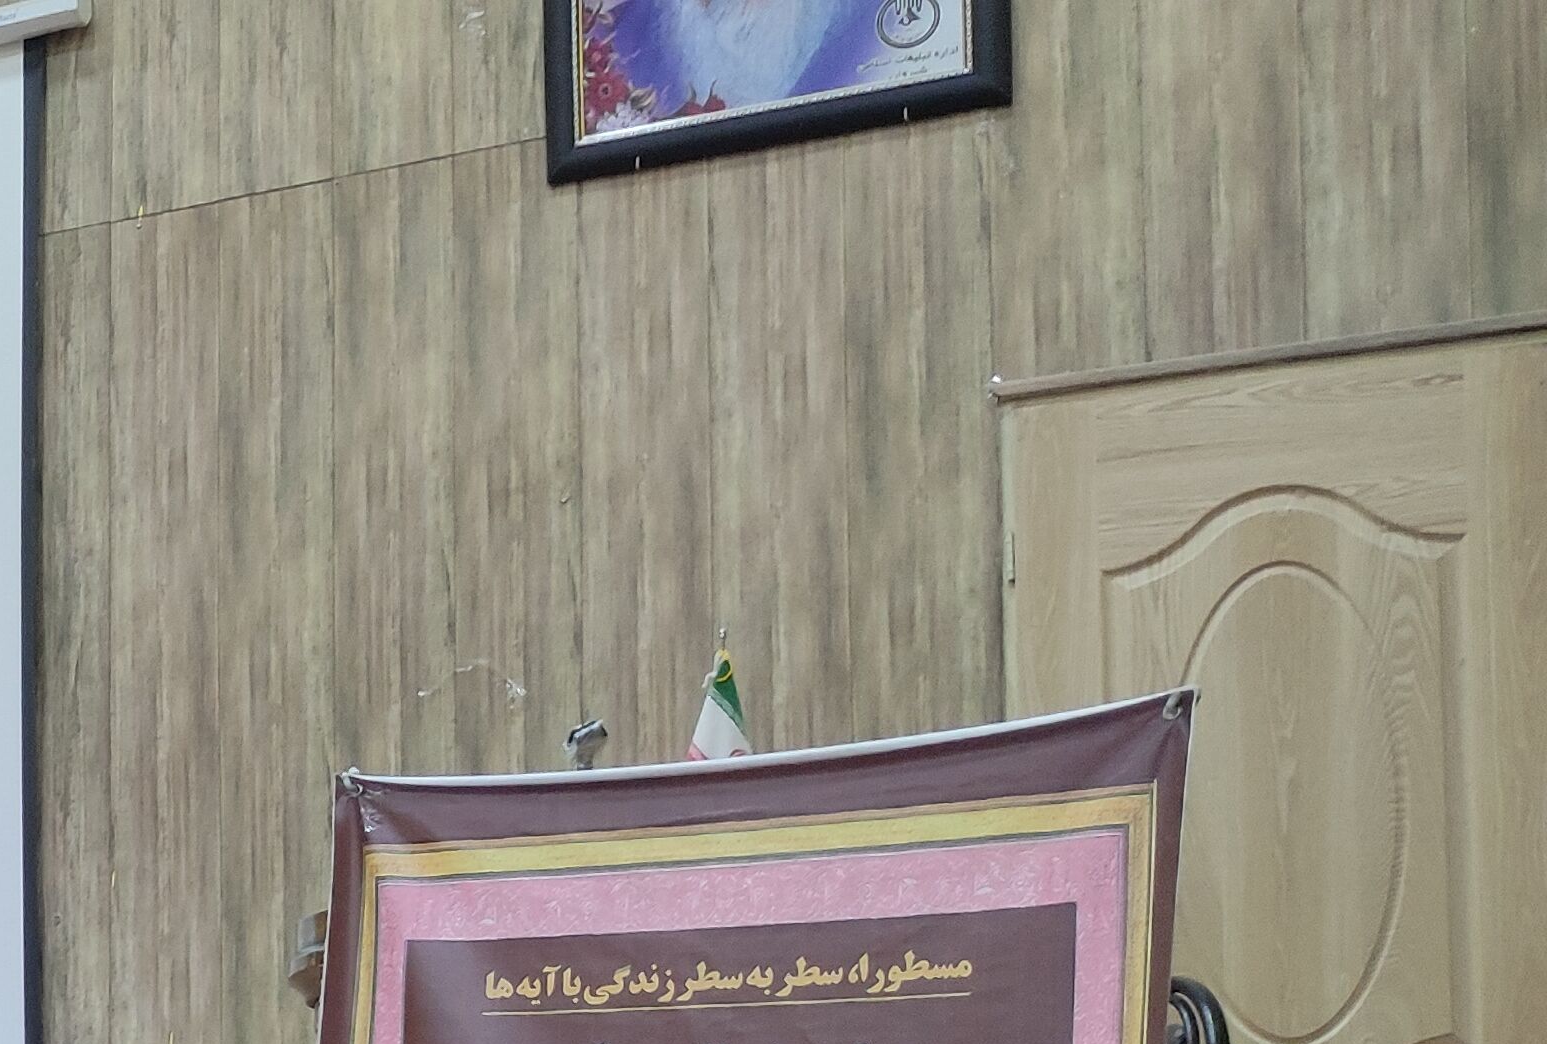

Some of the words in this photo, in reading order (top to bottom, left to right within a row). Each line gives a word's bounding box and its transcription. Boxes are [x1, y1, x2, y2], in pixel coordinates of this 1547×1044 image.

[561, 966, 583, 1003] با
[583, 962, 675, 1005] زندگی
[681, 961, 744, 1002] سطر
[746, 961, 775, 997] به
[775, 956, 844, 997] سطر
